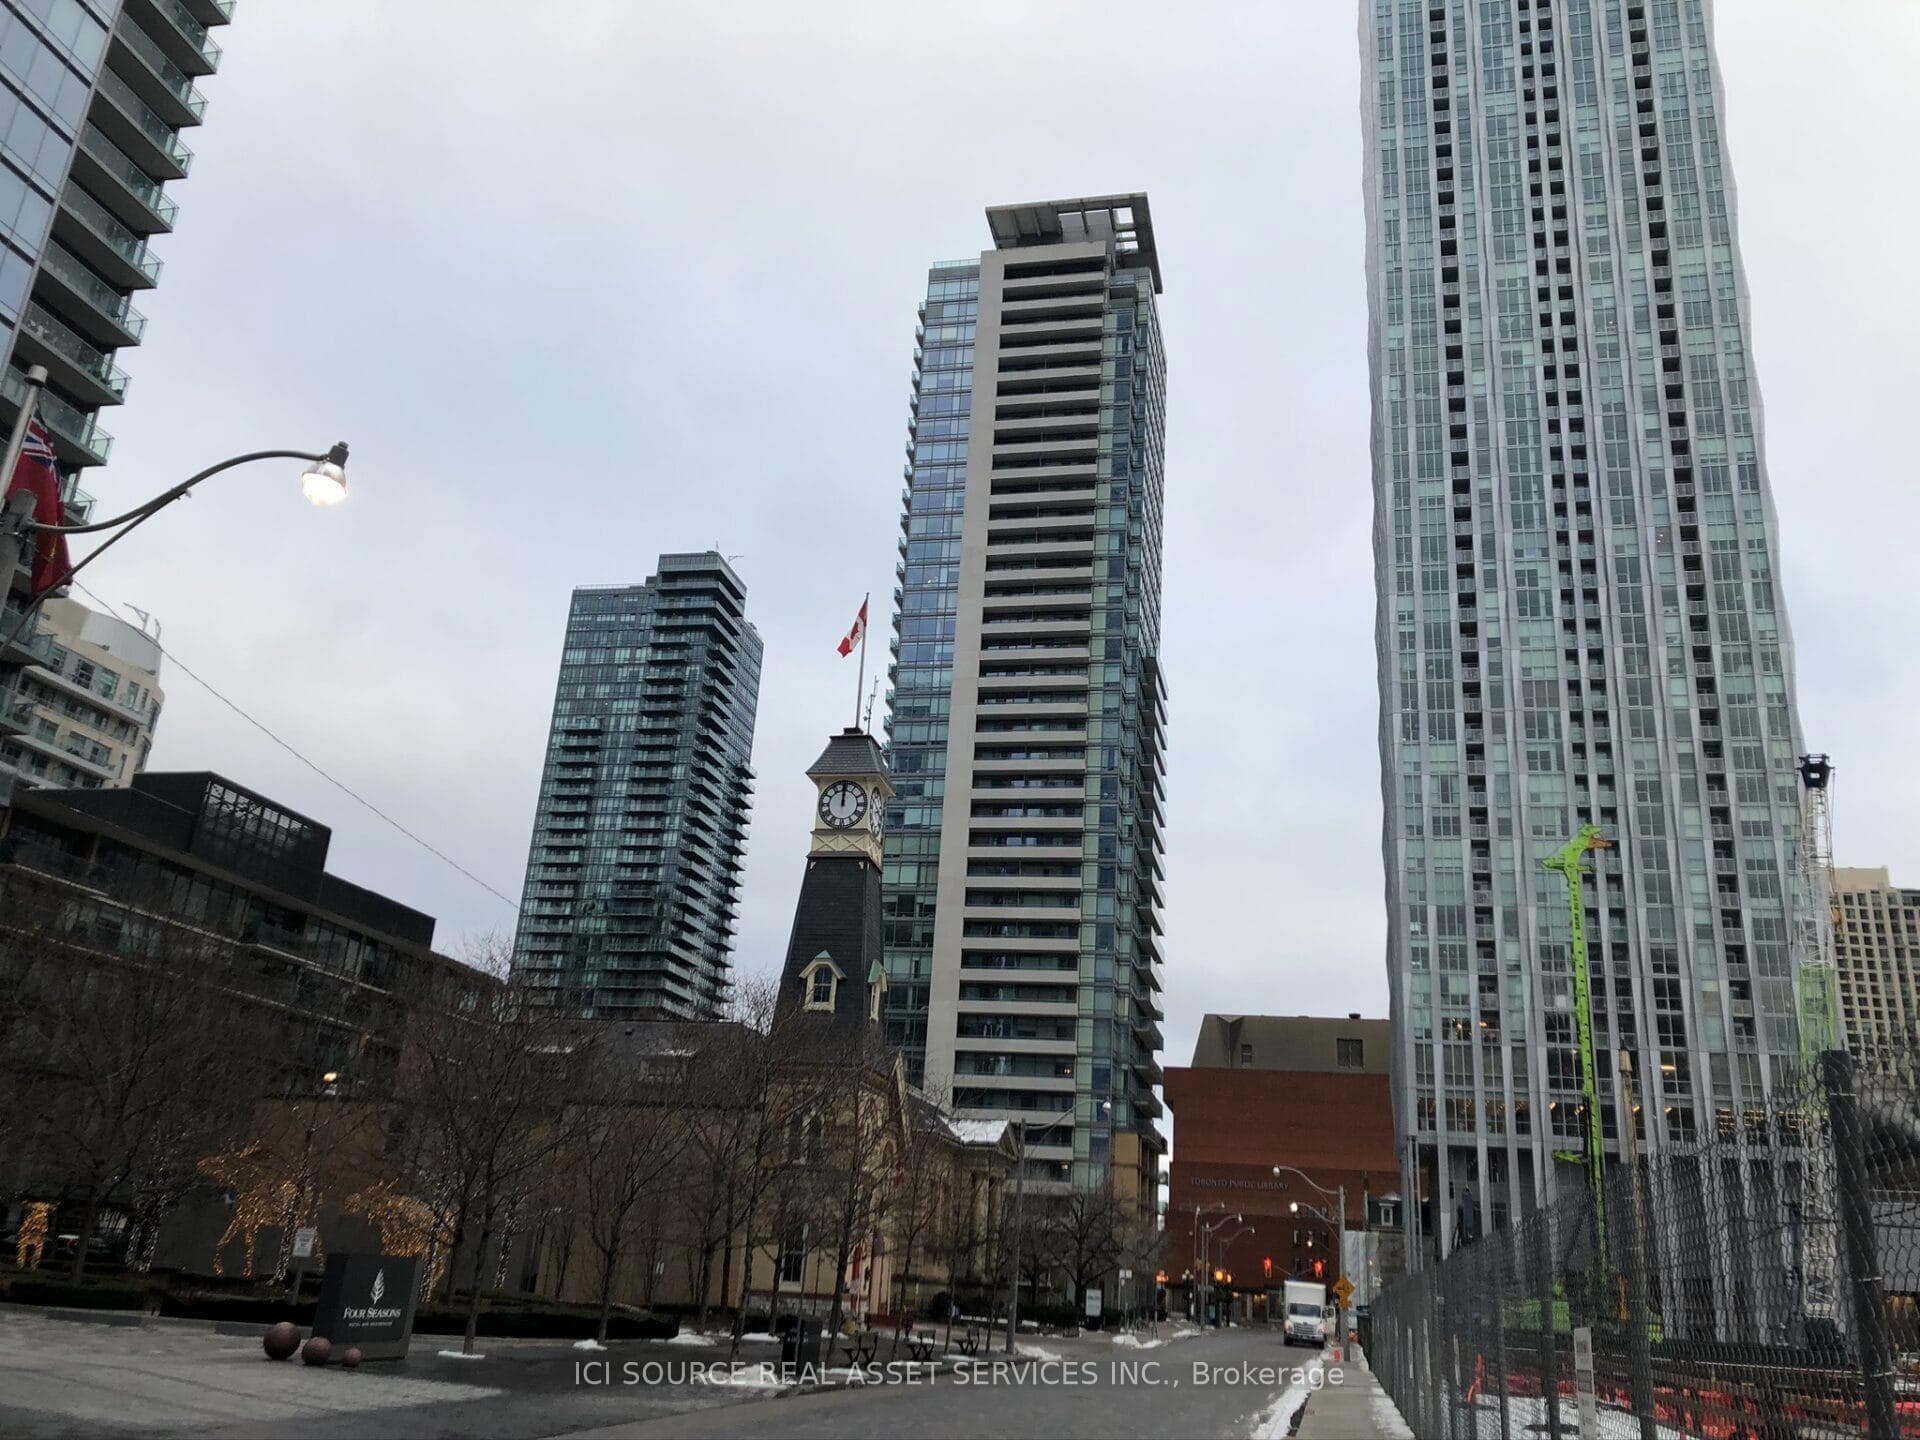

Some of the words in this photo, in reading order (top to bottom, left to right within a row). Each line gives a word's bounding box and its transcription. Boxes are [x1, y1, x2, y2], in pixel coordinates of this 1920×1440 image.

[1191, 1176, 1228, 1187] TORONTO
[1257, 1181, 1289, 1191] LIBRARY
[343, 1307, 366, 1319] FOUR
[366, 1307, 401, 1318] SEASONS
